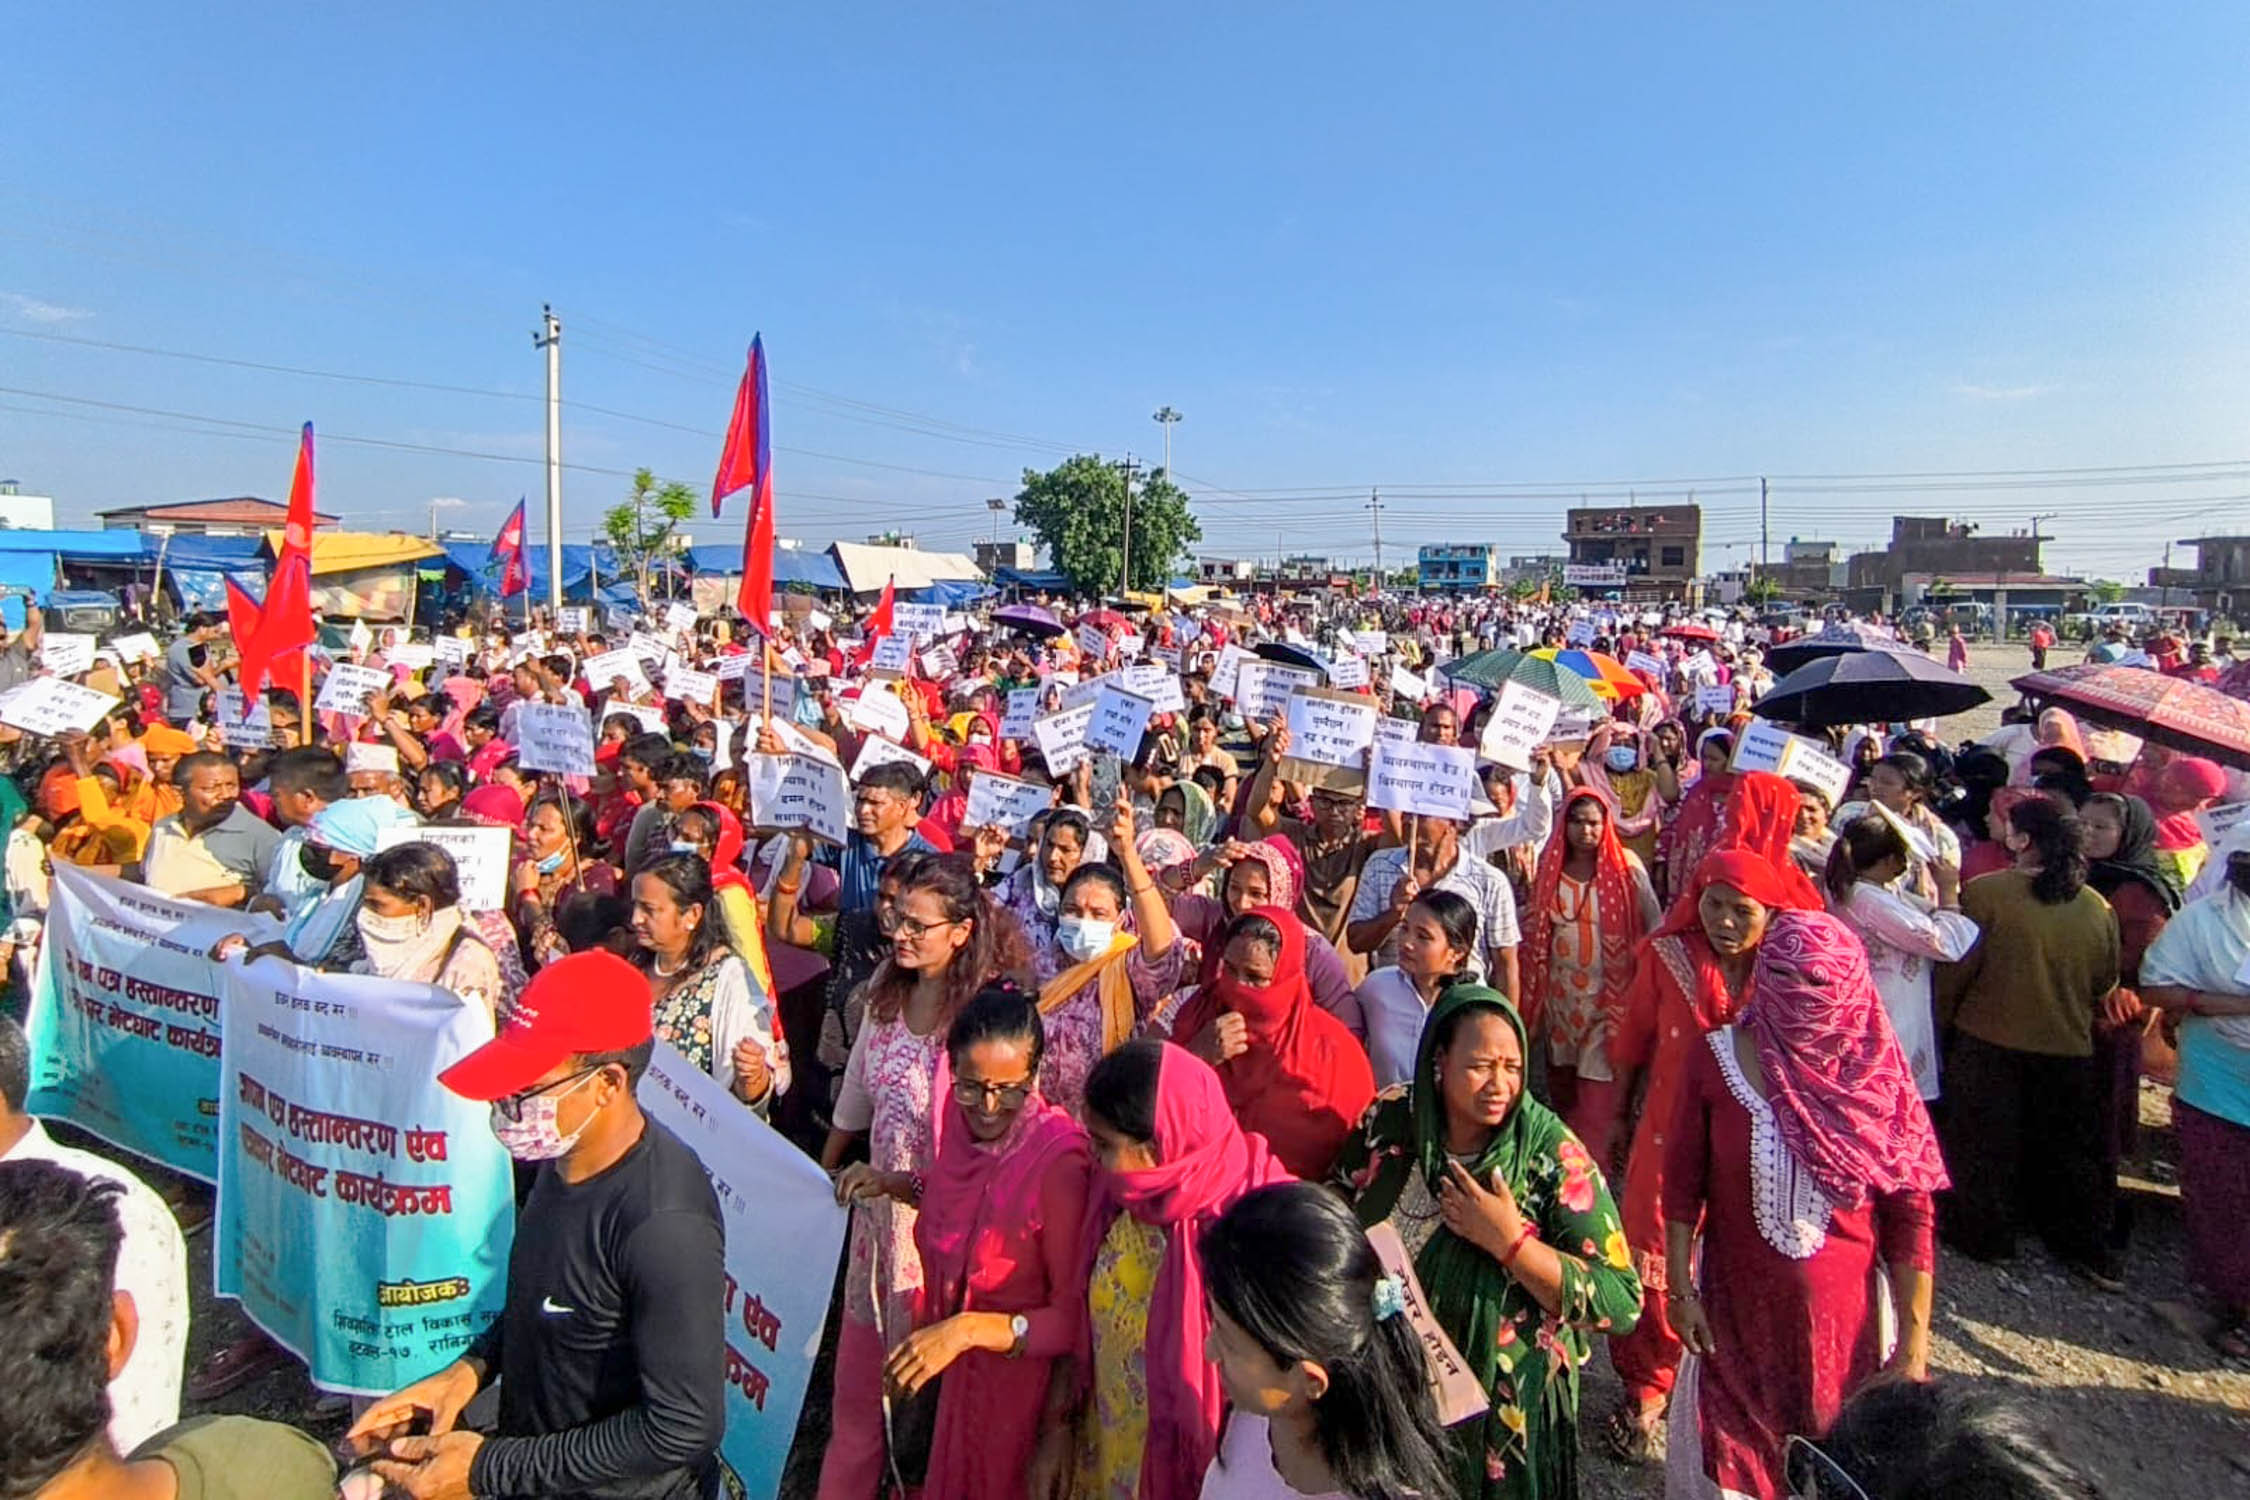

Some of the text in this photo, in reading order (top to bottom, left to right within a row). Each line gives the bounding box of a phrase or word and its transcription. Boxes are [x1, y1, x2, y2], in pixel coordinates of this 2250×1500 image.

[126, 975, 220, 1020] हस्तान्तरण
[288, 1102, 398, 1160] हस्तान्तरण
[336, 1169, 452, 1218] कार्यक्रम
[422, 1312, 472, 1332] विकास
